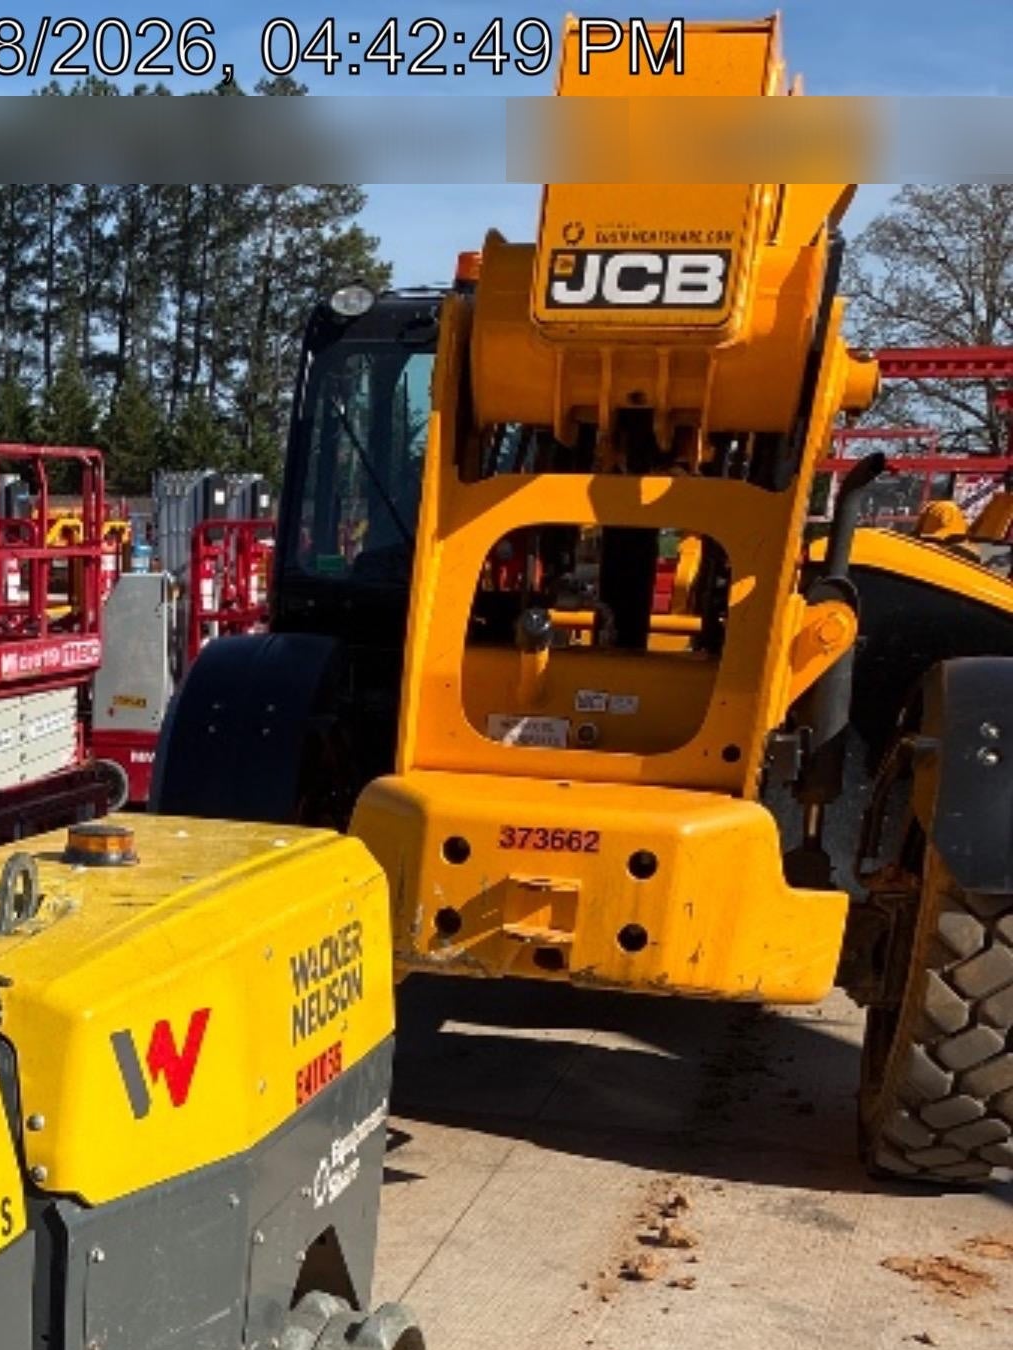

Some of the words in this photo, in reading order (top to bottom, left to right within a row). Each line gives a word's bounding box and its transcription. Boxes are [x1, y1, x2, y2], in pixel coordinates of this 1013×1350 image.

[550, 253, 727, 305] JCB
[499, 824, 601, 853] 373662
[290, 919, 363, 996] WACKER
[292, 961, 363, 1047] NEUSON
